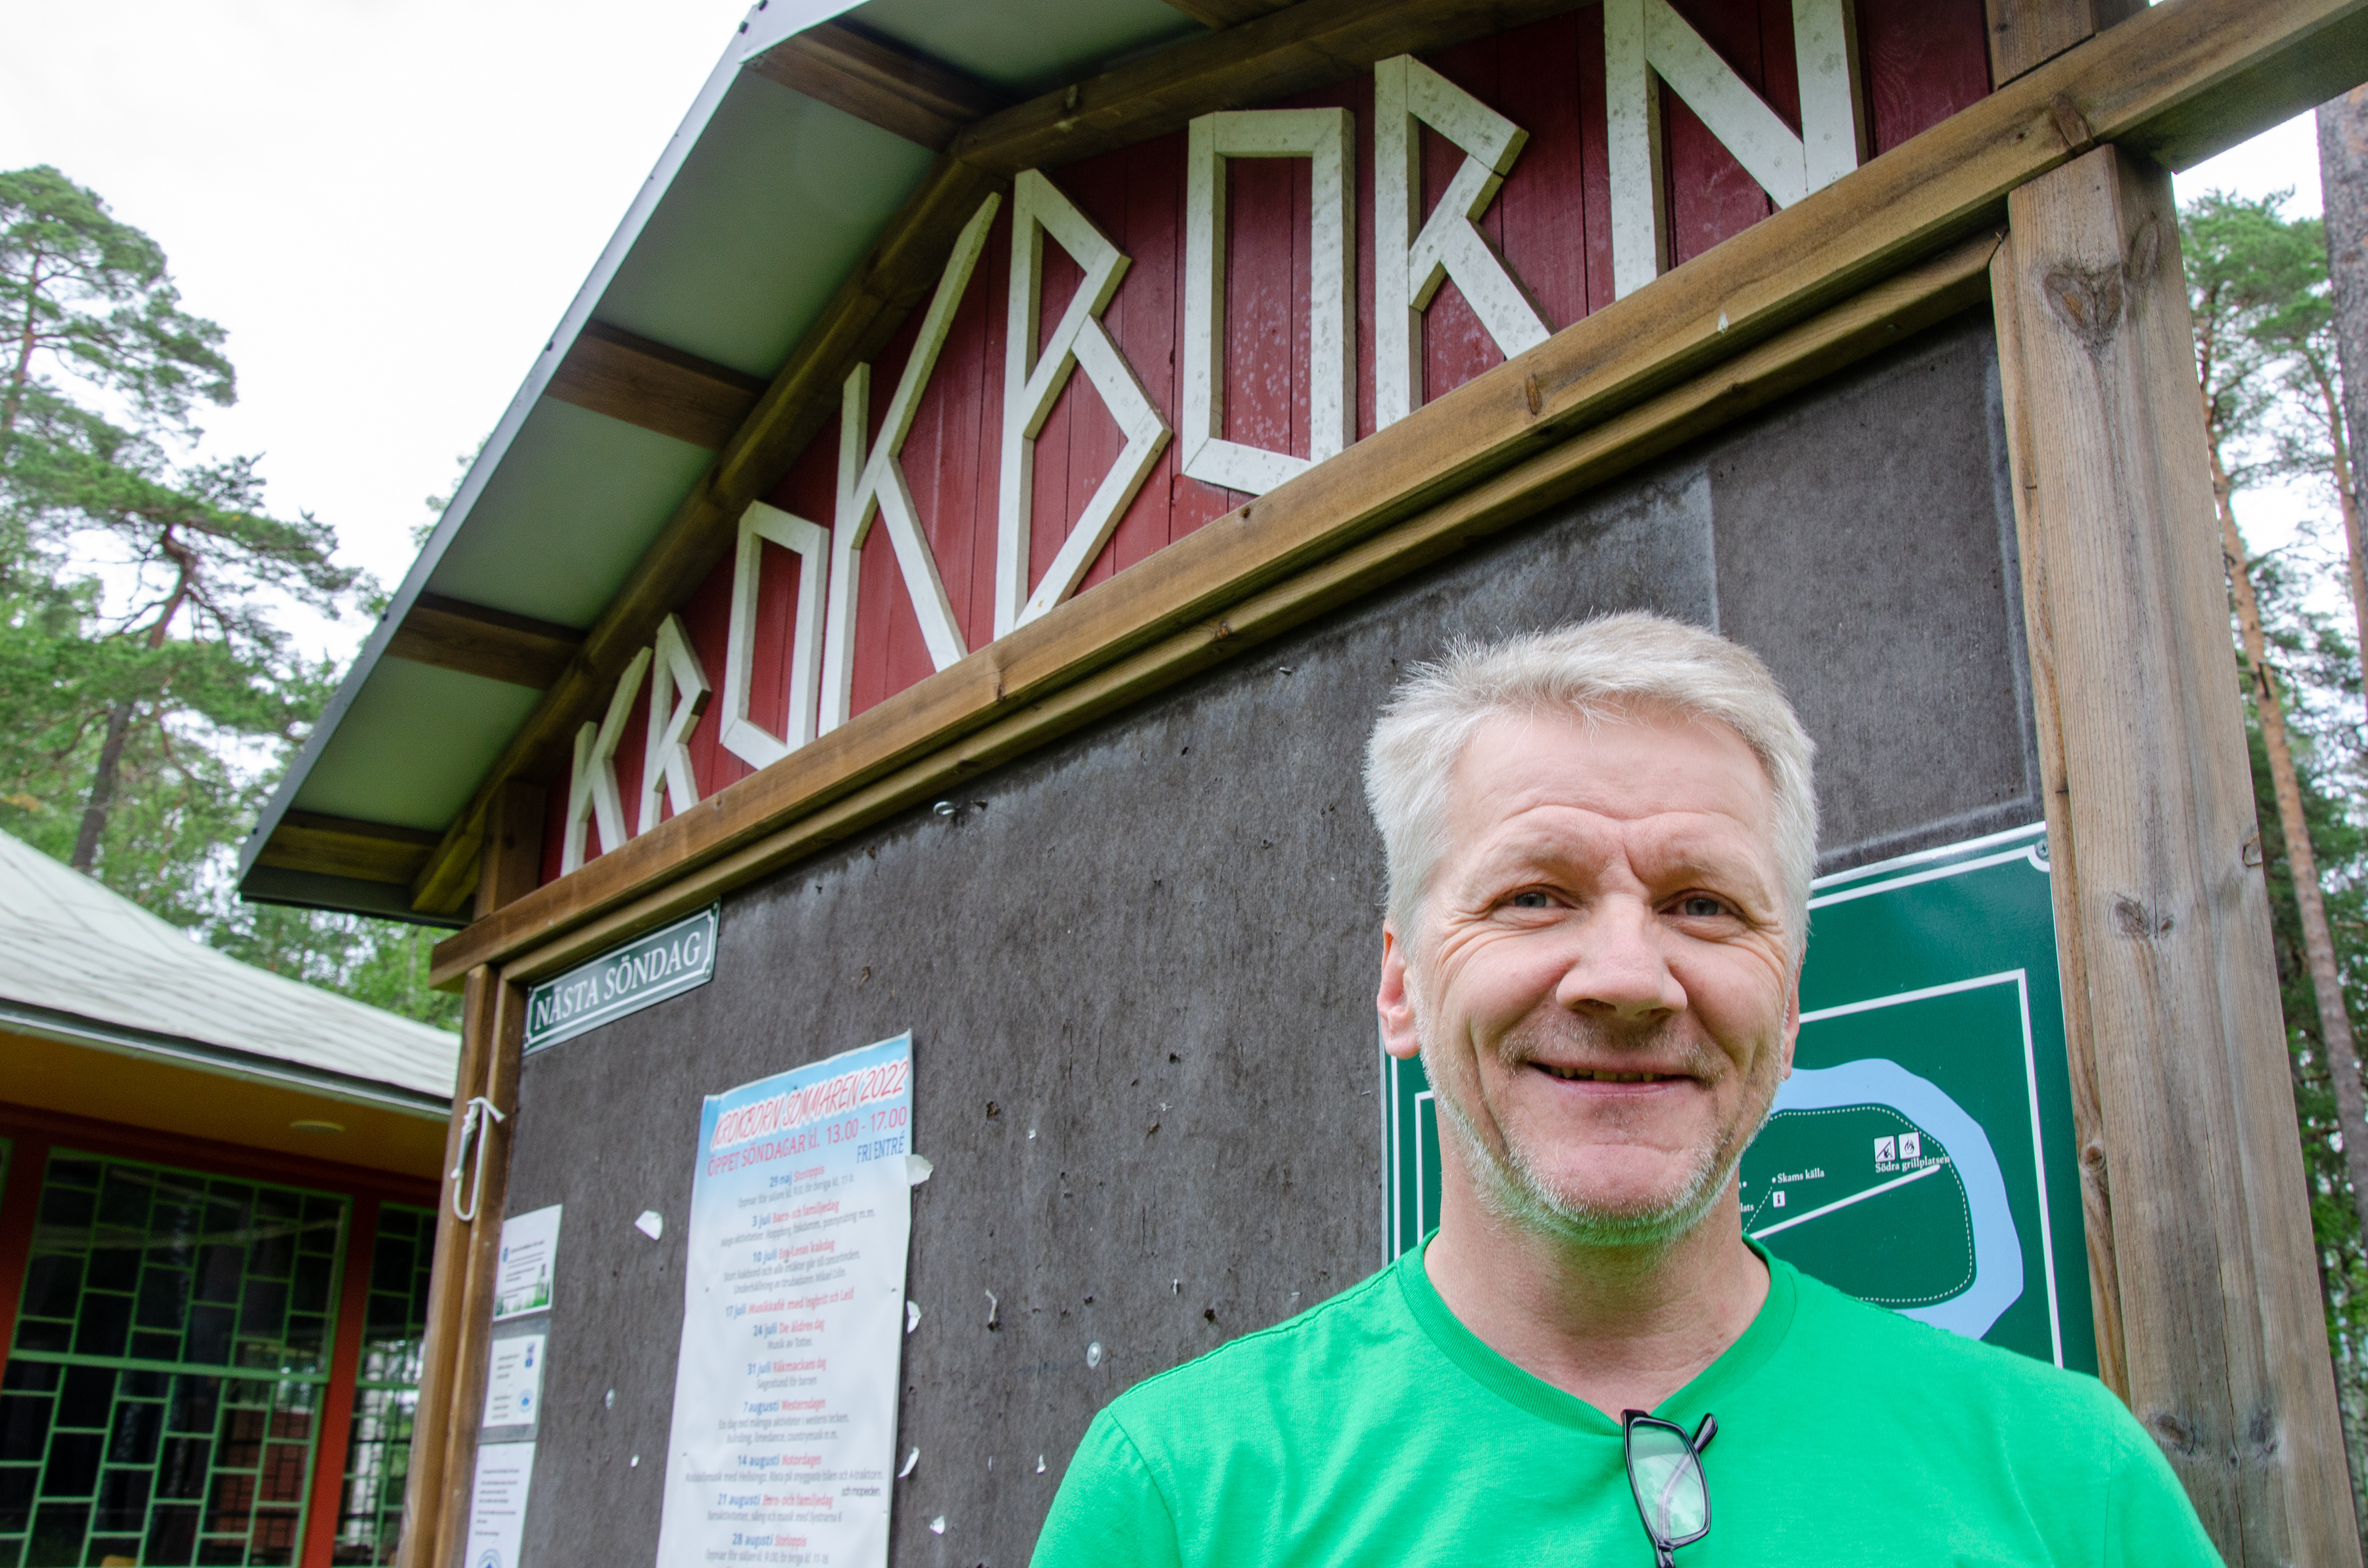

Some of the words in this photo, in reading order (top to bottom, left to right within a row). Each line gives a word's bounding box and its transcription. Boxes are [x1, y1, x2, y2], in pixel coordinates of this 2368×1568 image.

[561, 0, 1862, 876] KROKBORN
[534, 975, 599, 1030] NÄSTA
[604, 931, 701, 1001] SÖNDAG
[711, 1098, 785, 1148] KROKBORN
[783, 1072, 863, 1127] SOMMAREN
[861, 1060, 909, 1102] 2022
[707, 1151, 740, 1177] ÖPPET
[741, 1135, 806, 1167] SÖNDAGAR
[808, 1127, 821, 1149] kl.
[826, 1118, 858, 1144] 13.00
[871, 1106, 908, 1132] 17.00
[857, 1143, 872, 1164] FRI
[874, 1131, 905, 1159] ENTRÉ
[1875, 1160, 1899, 1174] Södra
[1902, 1154, 1950, 1172] grillplatsen
[770, 1176, 778, 1188] 29
[1777, 1172, 1804, 1184] Skams
[1805, 1167, 1825, 1180] källa
[752, 1216, 757, 1227] 3
[759, 1213, 771, 1229] juli
[803, 1200, 840, 1216] familjedag
[1740, 1202, 1754, 1213] lats
[753, 1251, 763, 1262] 10
[763, 1249, 777, 1265] juli
[726, 1305, 733, 1317] 17
[734, 1303, 747, 1319] juli
[787, 1295, 804, 1310] med
[753, 1325, 763, 1336] 24
[764, 1322, 777, 1339] juli
[779, 1323, 789, 1334] De
[748, 1363, 756, 1375] 31
[757, 1360, 771, 1377] juli
[744, 1401, 748, 1413] 7
[748, 1400, 780, 1416] augusti
[738, 1455, 747, 1466] 14
[749, 1454, 781, 1470] augusti
[717, 1494, 727, 1505] 21
[729, 1494, 762, 1508] augusti
[797, 1494, 834, 1509] familjedag
[732, 1533, 743, 1546] 28
[745, 1534, 774, 1549] augusti
